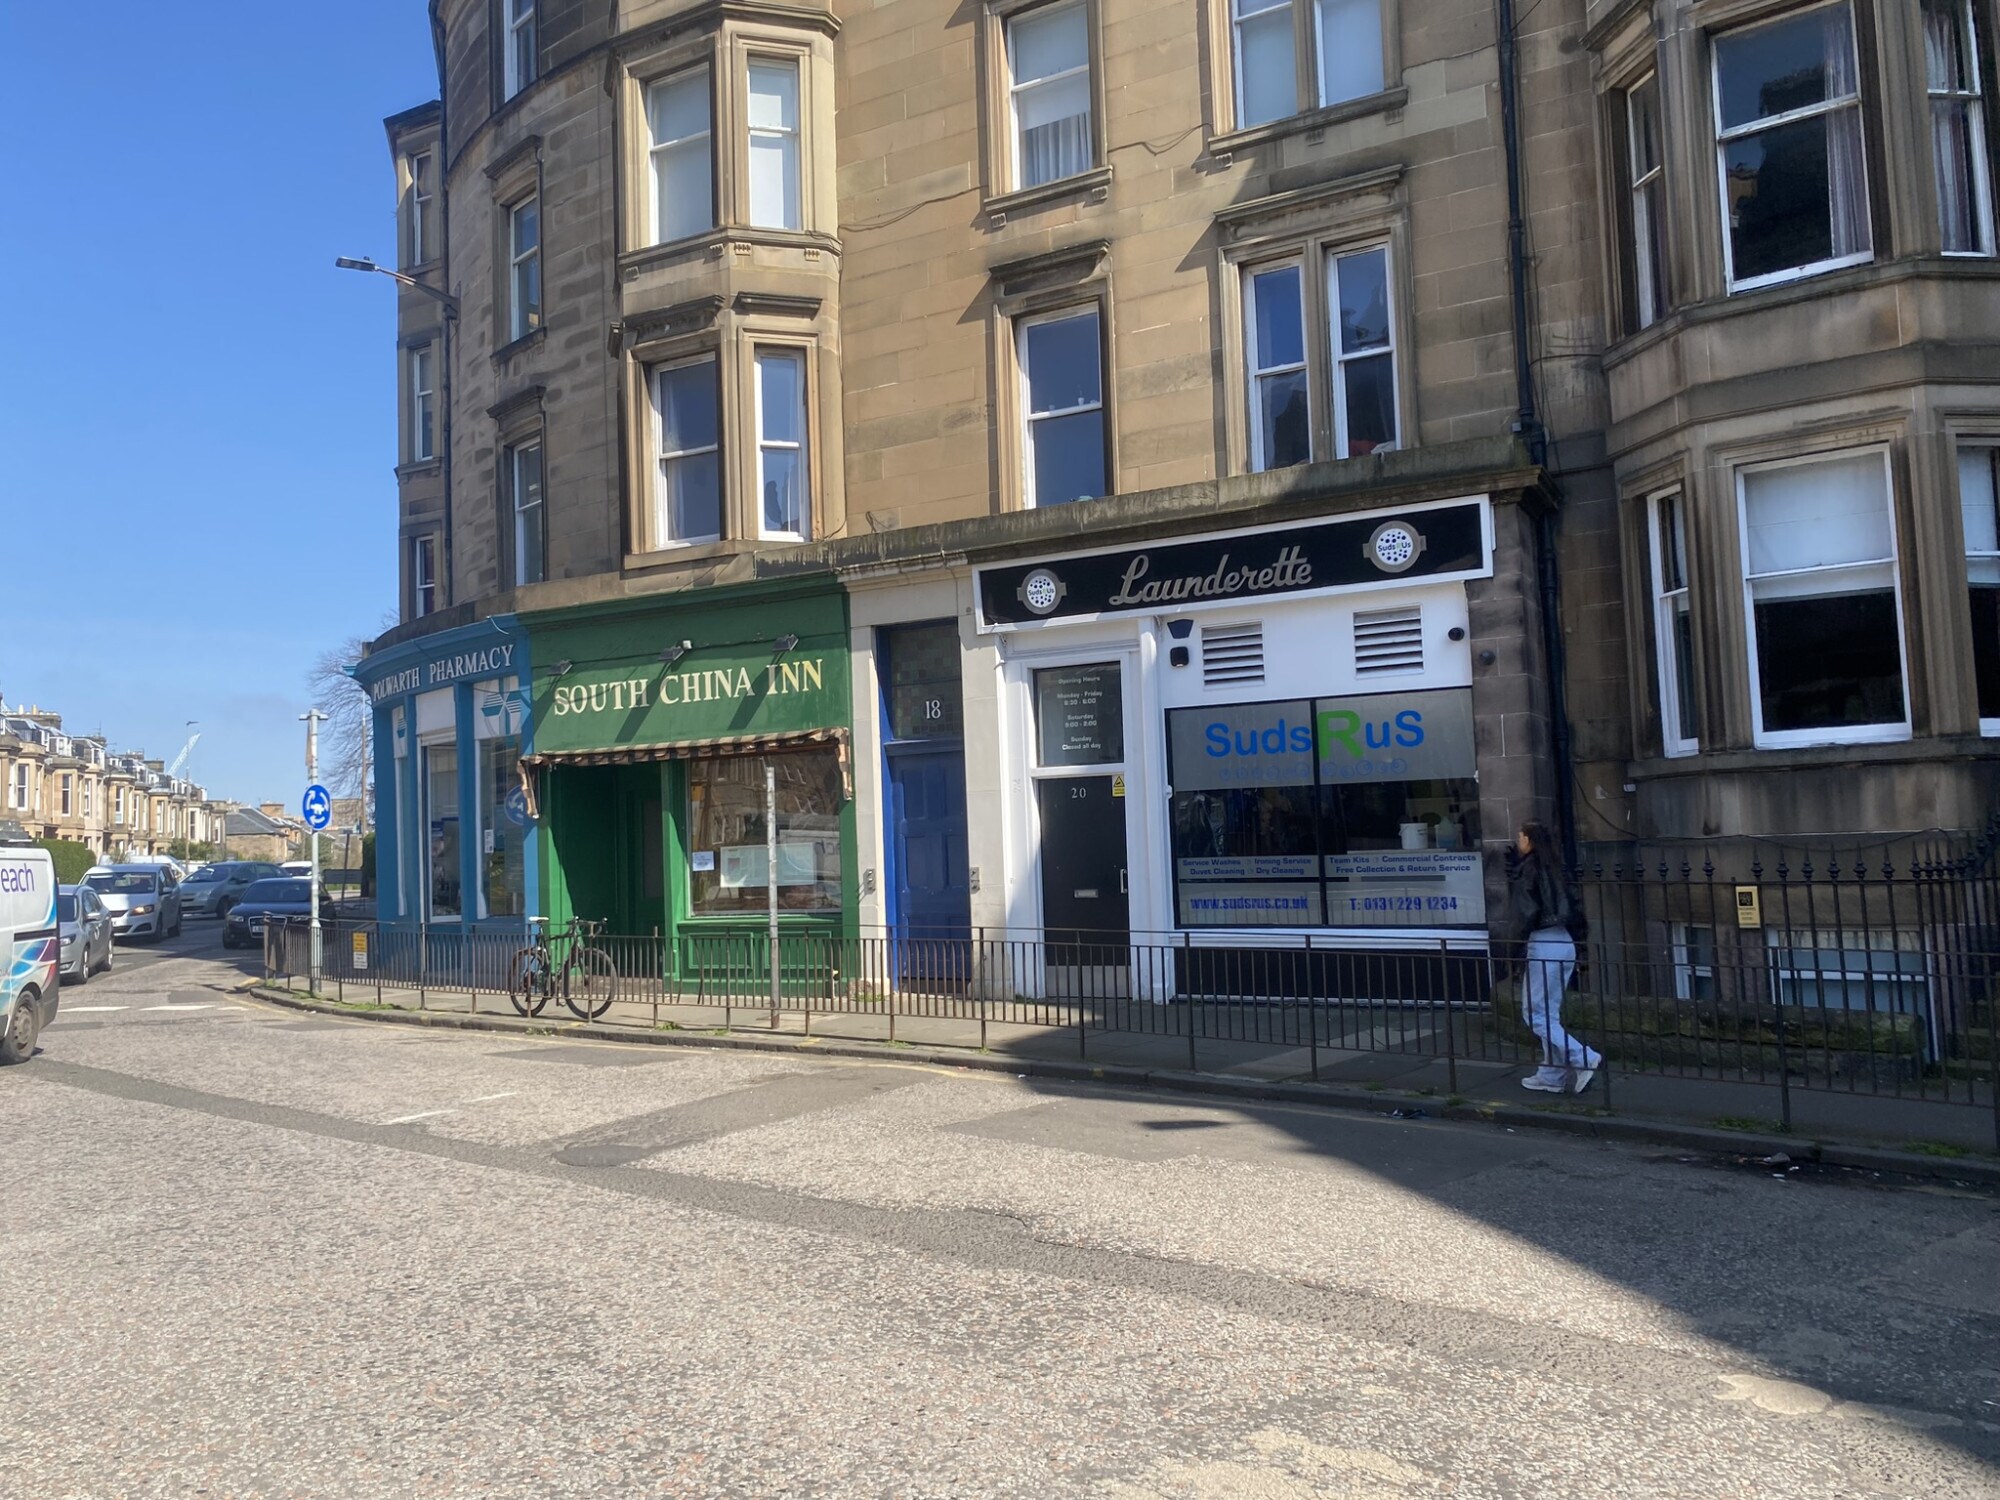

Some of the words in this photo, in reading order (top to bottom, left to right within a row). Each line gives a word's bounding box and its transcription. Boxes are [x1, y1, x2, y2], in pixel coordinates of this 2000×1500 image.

[1109, 545, 1312, 606] Launderette
[373, 667, 420, 702] POLWARTH
[430, 644, 514, 684] PHARMACY
[554, 678, 650, 716] SOUTH
[659, 666, 755, 705] CHINA
[766, 659, 823, 695] INN
[925, 699, 941, 719] 18
[1070, 787, 1086, 799] 20
[1212, 858, 1241, 866] Washes
[1254, 858, 1281, 866] Ironing
[1282, 857, 1311, 865] Service
[1382, 855, 1431, 863] Commercial
[1433, 854, 1476, 862] Contracts
[1213, 867, 1245, 876] Cleaning
[1256, 867, 1270, 875] Dry
[1271, 867, 1304, 875] Cleaning
[1356, 865, 1396, 873] Collection
[1439, 864, 1471, 872] Service
[1190, 896, 1308, 910] www.sudsrus.co.uk
[1364, 897, 1393, 910] 0131
[1397, 897, 1422, 910] 229
[1426, 897, 1457, 910] 1234
